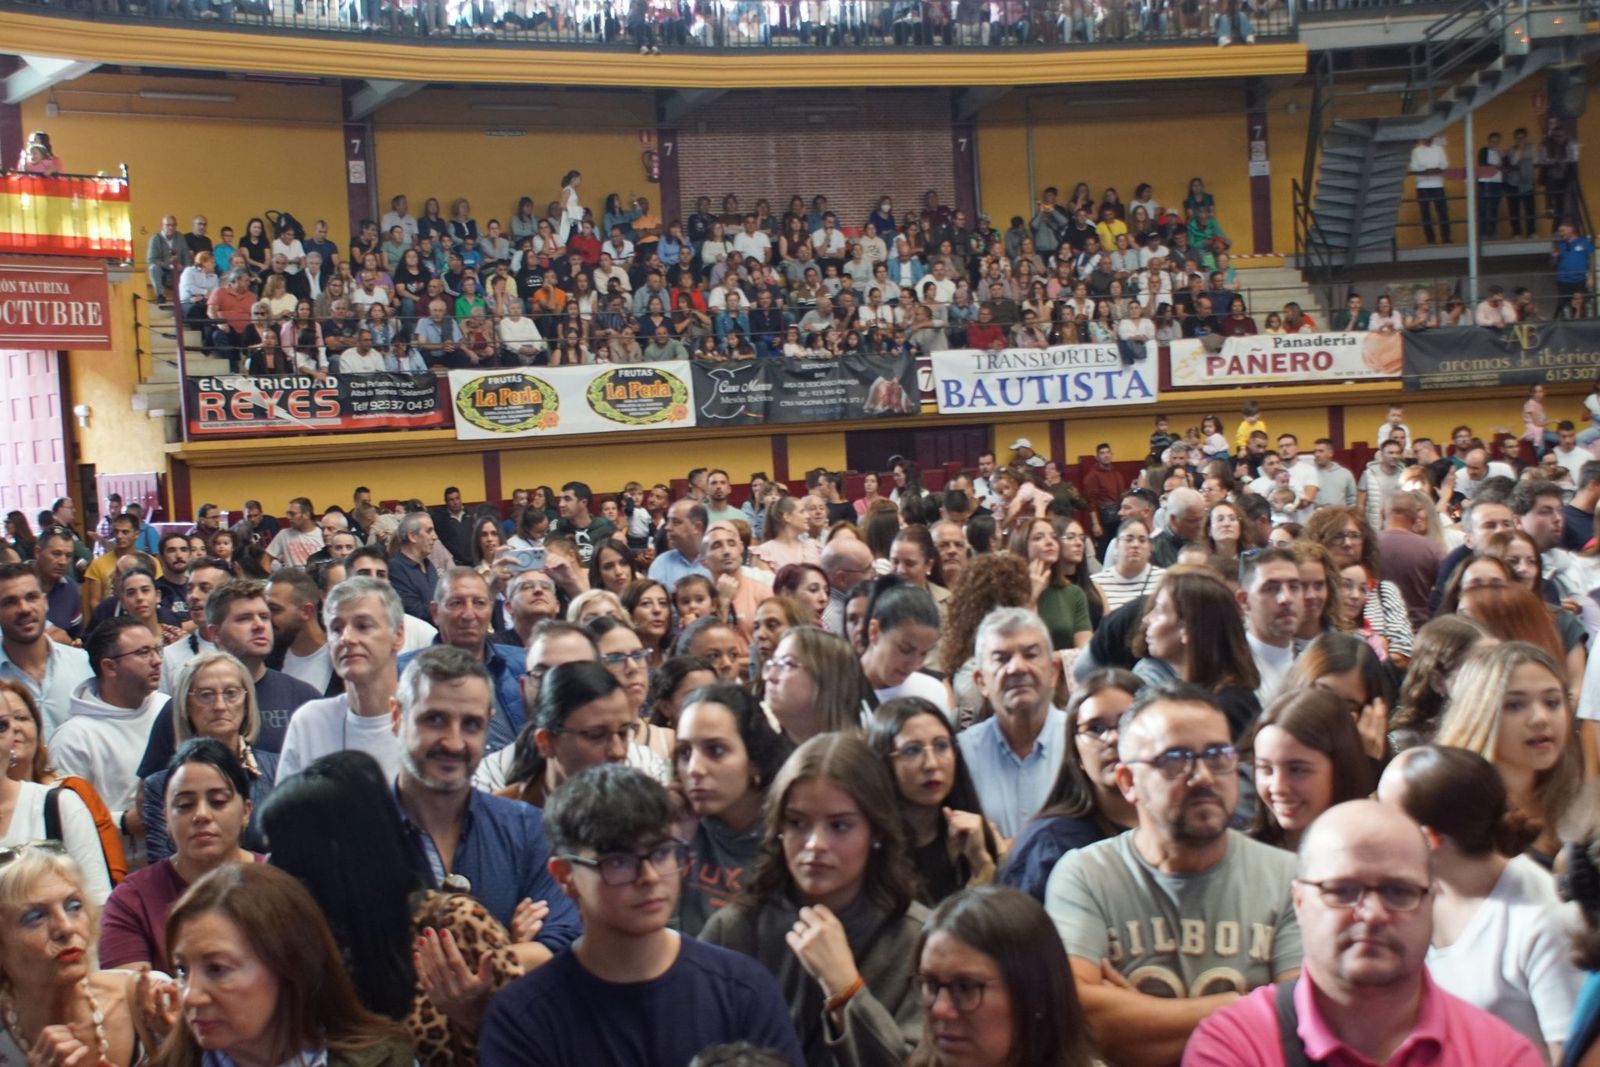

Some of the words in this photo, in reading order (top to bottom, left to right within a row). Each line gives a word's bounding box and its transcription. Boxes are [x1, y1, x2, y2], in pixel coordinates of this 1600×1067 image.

[351, 140, 361, 154] 7
[663, 142, 673, 156] 7
[958, 138, 967, 152] 7
[19, 281, 71, 294] TAURINA
[0, 299, 103, 326] CTUBRE
[1272, 334, 1357, 348] Panadería
[972, 347, 1118, 370] TRANSPORTES
[1206, 348, 1334, 377] PAÑERO
[1438, 358, 1510, 372] aromas
[488, 375, 523, 384] FRUTAS
[618, 369, 654, 378] FRUTAS
[606, 382, 628, 400] La
[628, 380, 672, 399] Perla
[941, 369, 1154, 408] BAUTISTA
[475, 388, 498, 407] La
[498, 385, 542, 406] Perla
[198, 389, 341, 421] REYES
